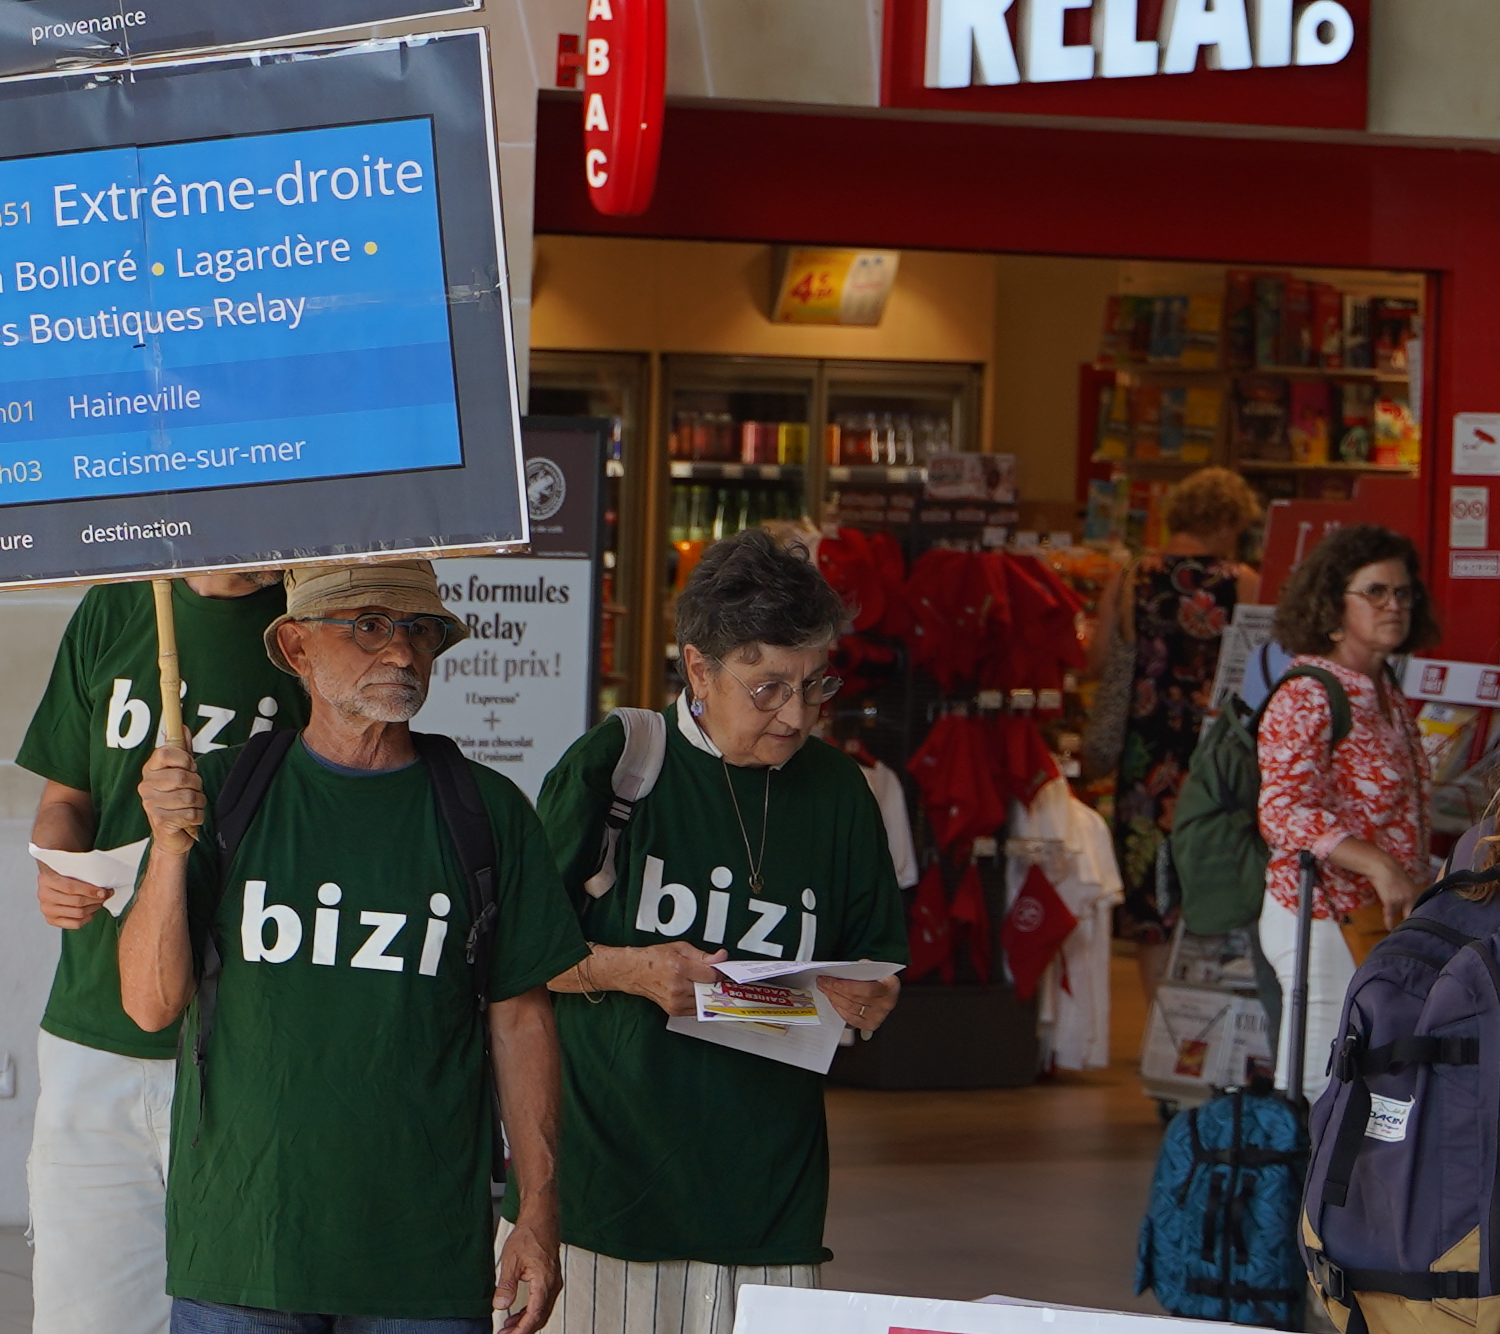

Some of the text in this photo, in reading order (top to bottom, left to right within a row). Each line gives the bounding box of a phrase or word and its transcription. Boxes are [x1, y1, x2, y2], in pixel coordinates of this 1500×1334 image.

[31, 9, 147, 45] provenance
[53, 151, 424, 228] Extrême-droite
[15, 249, 138, 294] Bolloré
[176, 234, 351, 287] Lagardère
[31, 298, 205, 347] Boutiques
[214, 289, 307, 332] Relay
[69, 385, 201, 419] Haineville
[73, 438, 307, 480] Racisme-sur-mer
[81, 518, 192, 544] destination
[468, 575, 570, 605] formules
[465, 613, 527, 647] Relay
[444, 651, 498, 683] petit
[504, 650, 549, 683] prix
[635, 855, 817, 961] bizi
[240, 880, 452, 977] bizi
